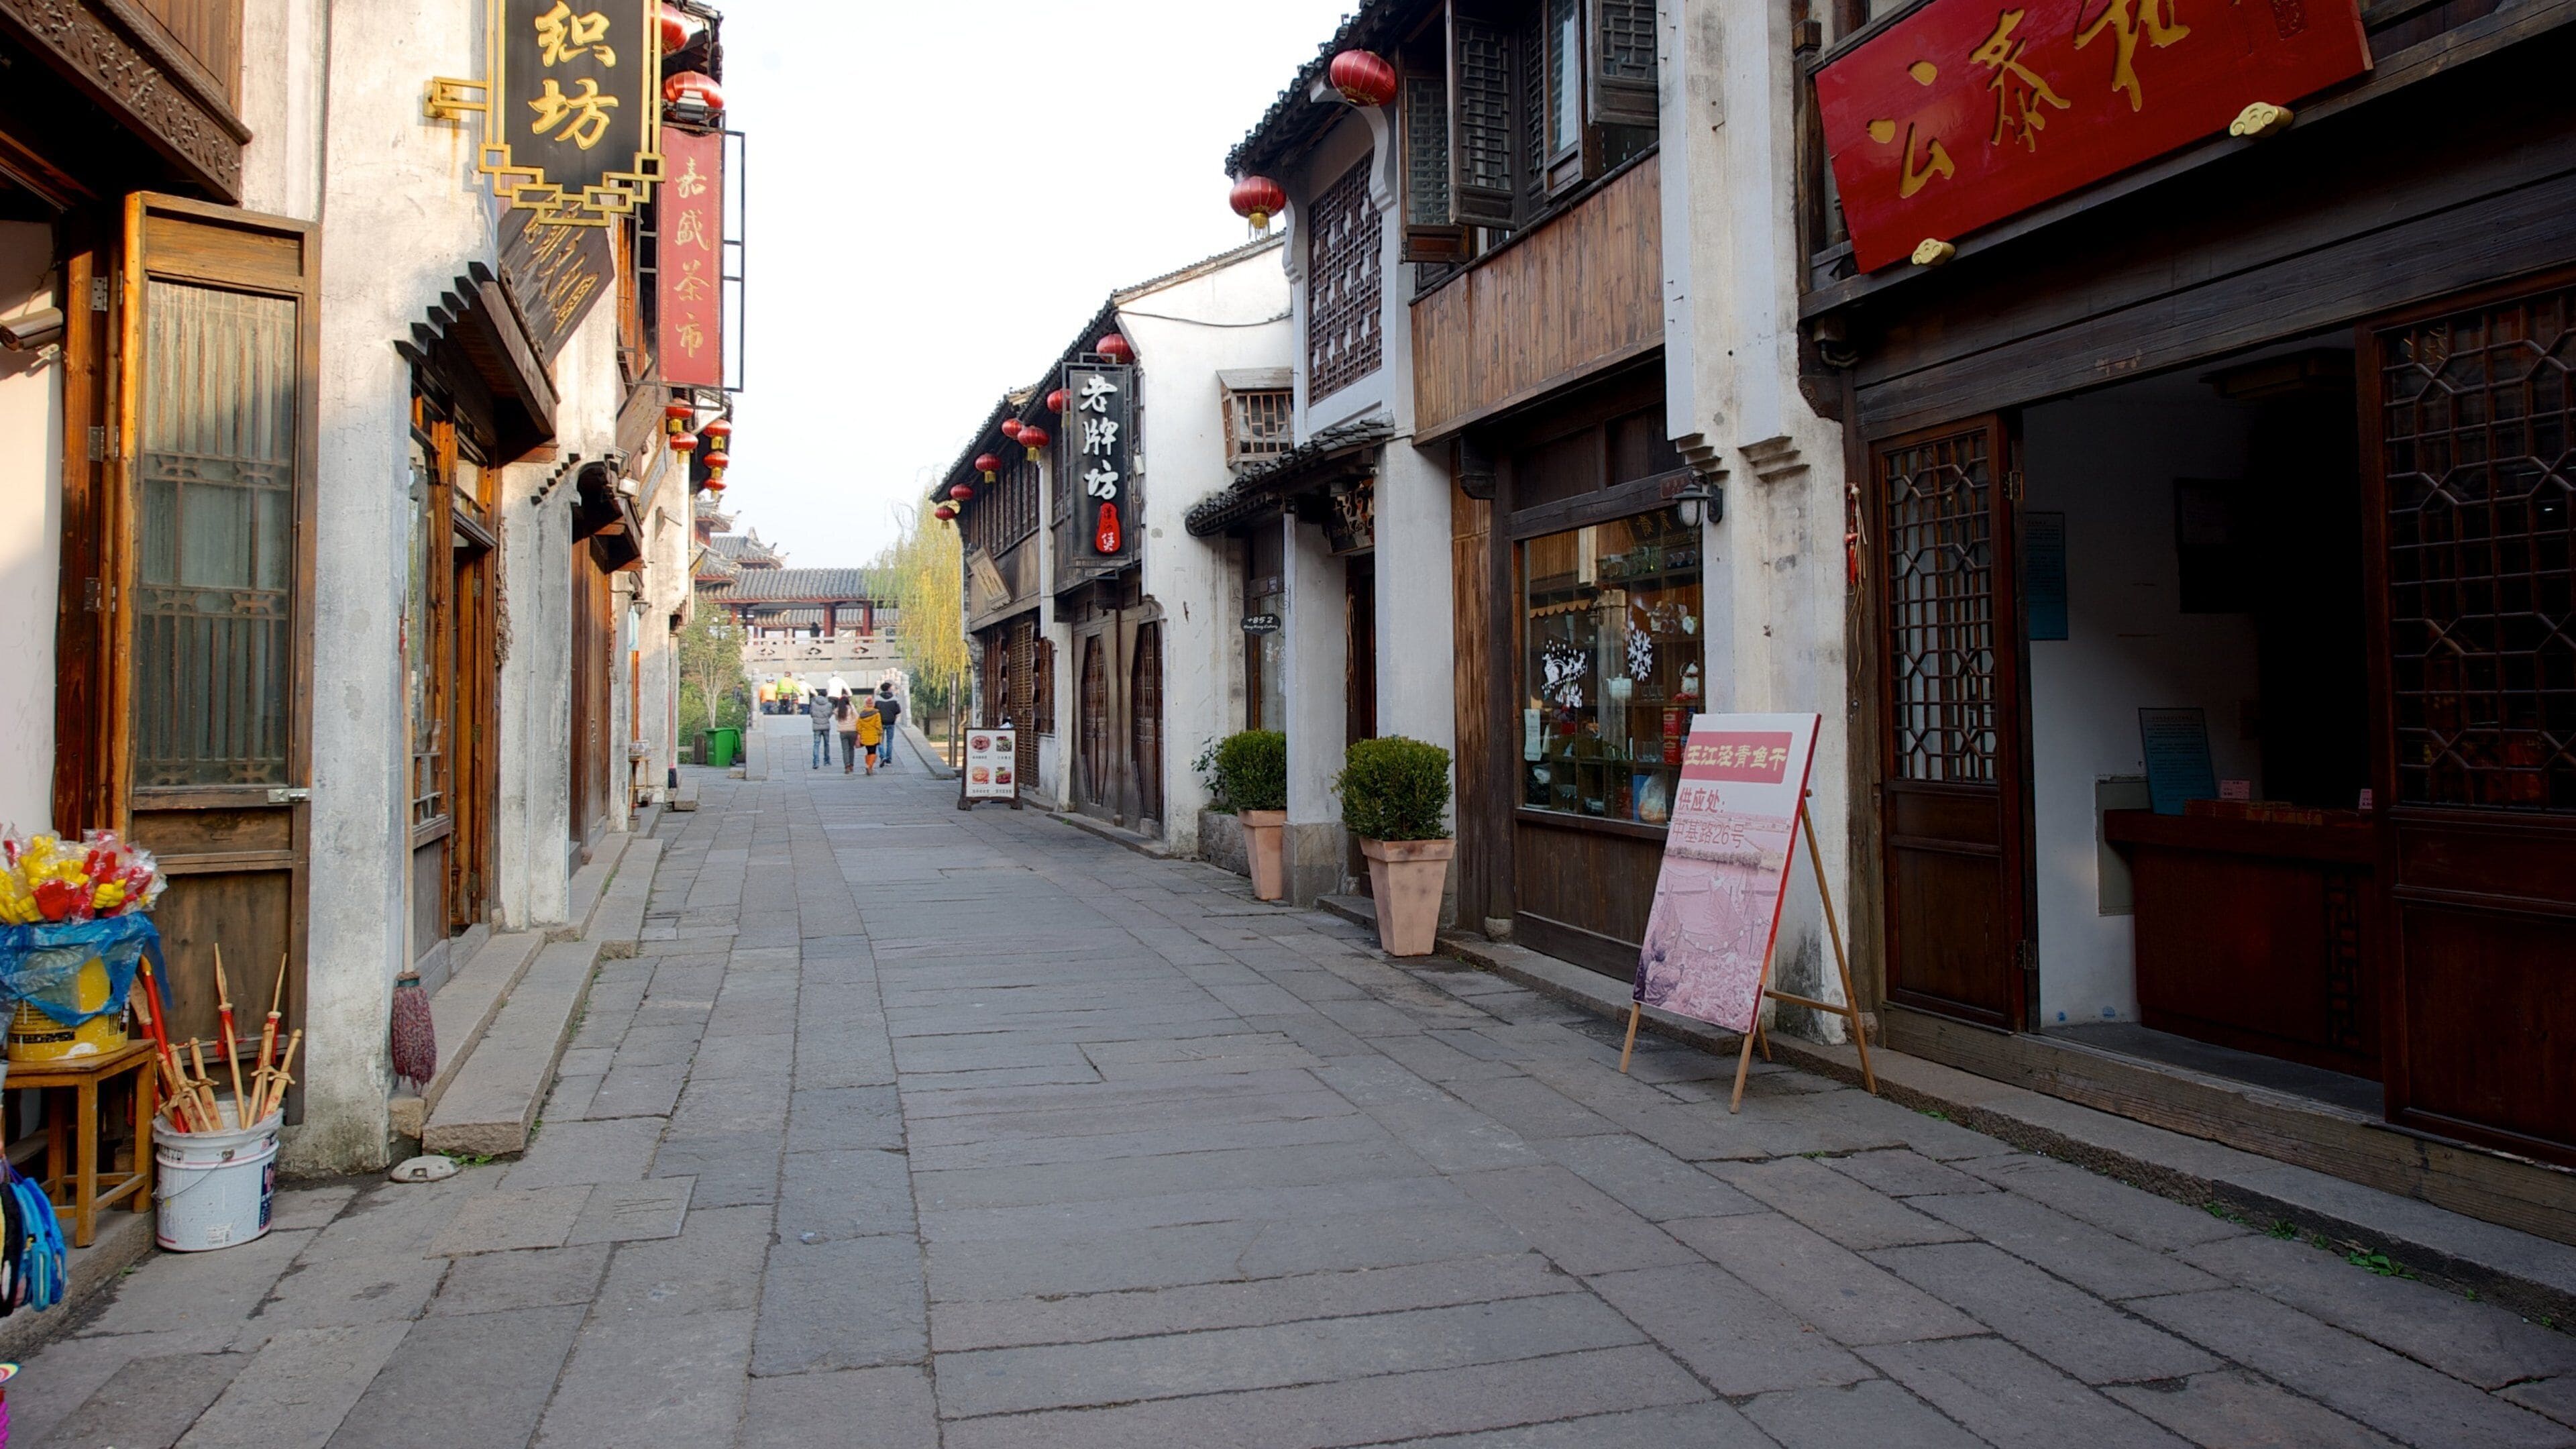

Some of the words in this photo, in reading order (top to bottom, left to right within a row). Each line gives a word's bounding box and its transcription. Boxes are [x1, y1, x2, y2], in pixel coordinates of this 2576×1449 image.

[1079, 374, 1119, 500] 老牌坊
[1684, 745, 1787, 771] 王江泾青鱼干
[1672, 818, 1745, 849] 中基路26号
